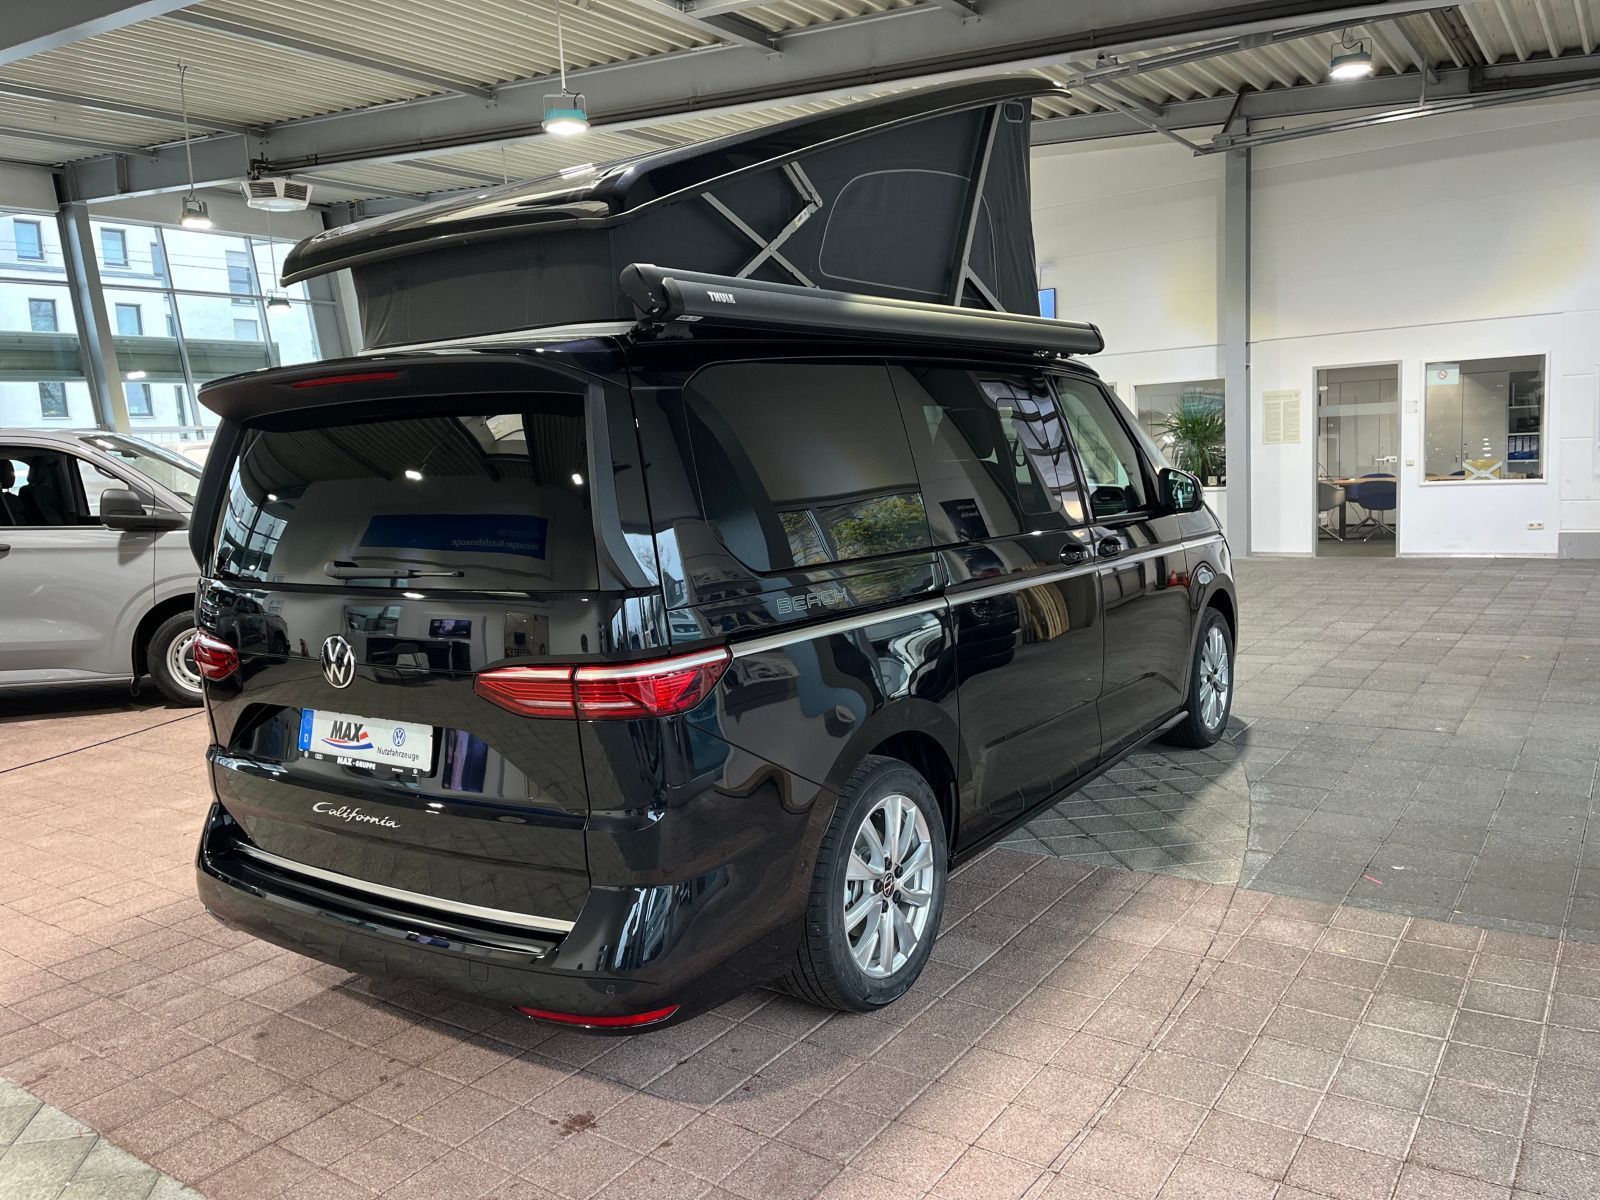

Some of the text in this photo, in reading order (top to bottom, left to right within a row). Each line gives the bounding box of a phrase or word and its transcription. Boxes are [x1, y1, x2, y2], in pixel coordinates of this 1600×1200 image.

[706, 291, 736, 304] THULE
[330, 720, 364, 743] MAX
[377, 746, 420, 761] Nutzfahrzeuge
[312, 801, 400, 828] California
